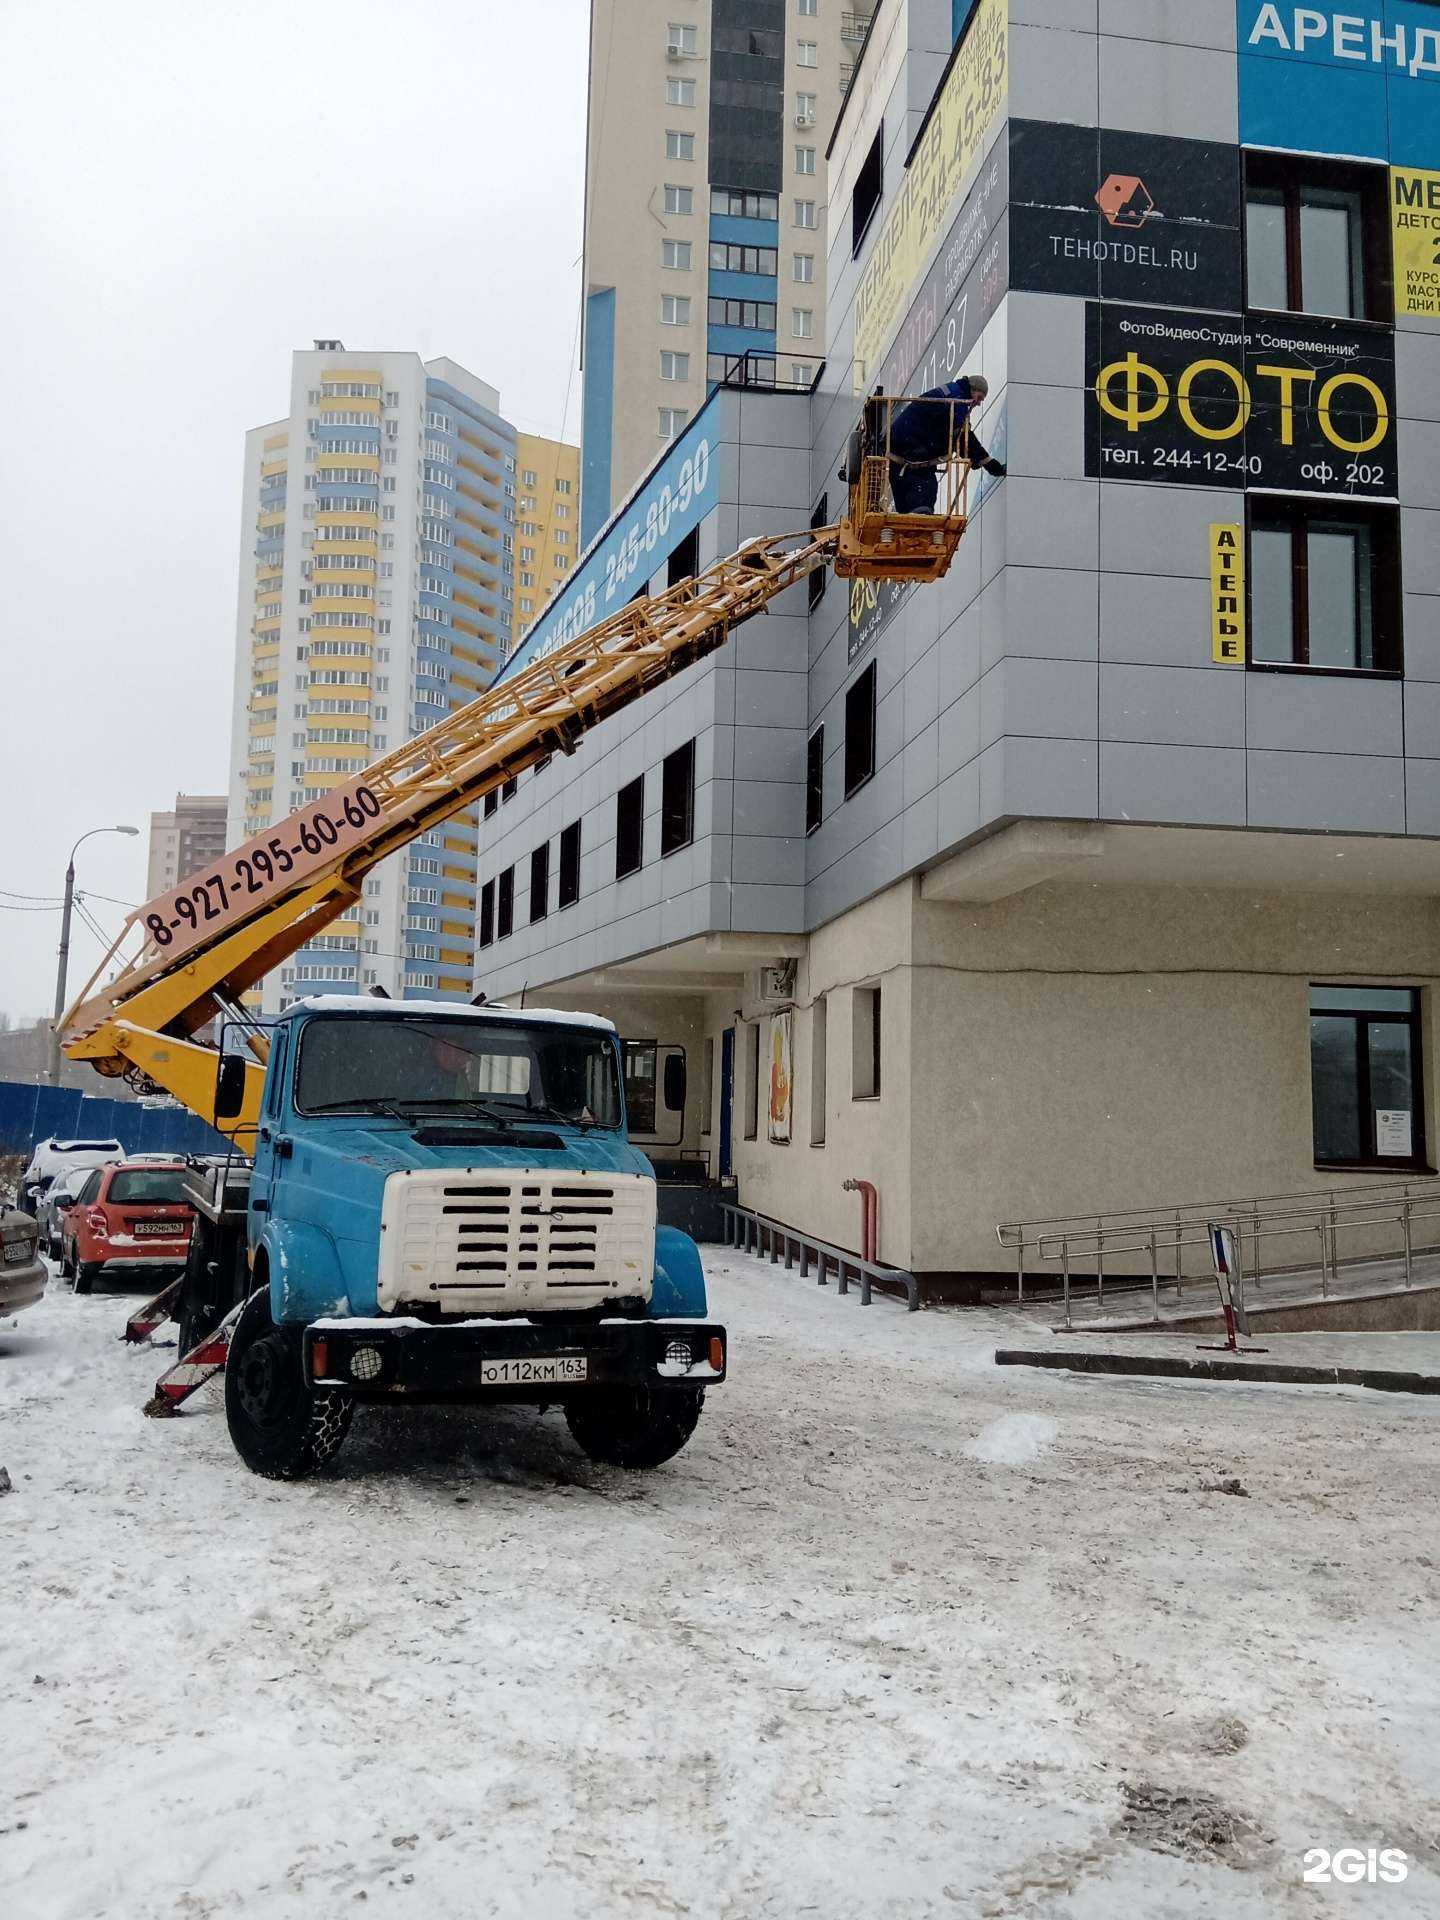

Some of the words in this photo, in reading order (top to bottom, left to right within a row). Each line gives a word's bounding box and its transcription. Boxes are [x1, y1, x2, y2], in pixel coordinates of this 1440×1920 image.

[1248, 3, 1440, 78] АРЕНД
[855, 109, 942, 336] МЕНДЕЛЕЕВ
[1049, 235, 1198, 271] TEHOTDEL.RU
[1119, 320, 1251, 346] ФотоВидеоСтудия
[1407, 298, 1434, 311] ДНИ
[1096, 352, 1389, 452] ФОТО
[1101, 448, 1145, 465] тел.
[1153, 447, 1262, 475] 244-12-40
[1300, 461, 1338, 485] оф.
[1346, 463, 1385, 485] 202
[605, 438, 709, 602] 245-80-90
[1216, 530, 1238, 658] АТЕЛЬЕ
[147, 786, 380, 946] 8-927-295-60-60
[486, 1362, 555, 1381] О112КМ
[558, 1359, 582, 1373] 163
